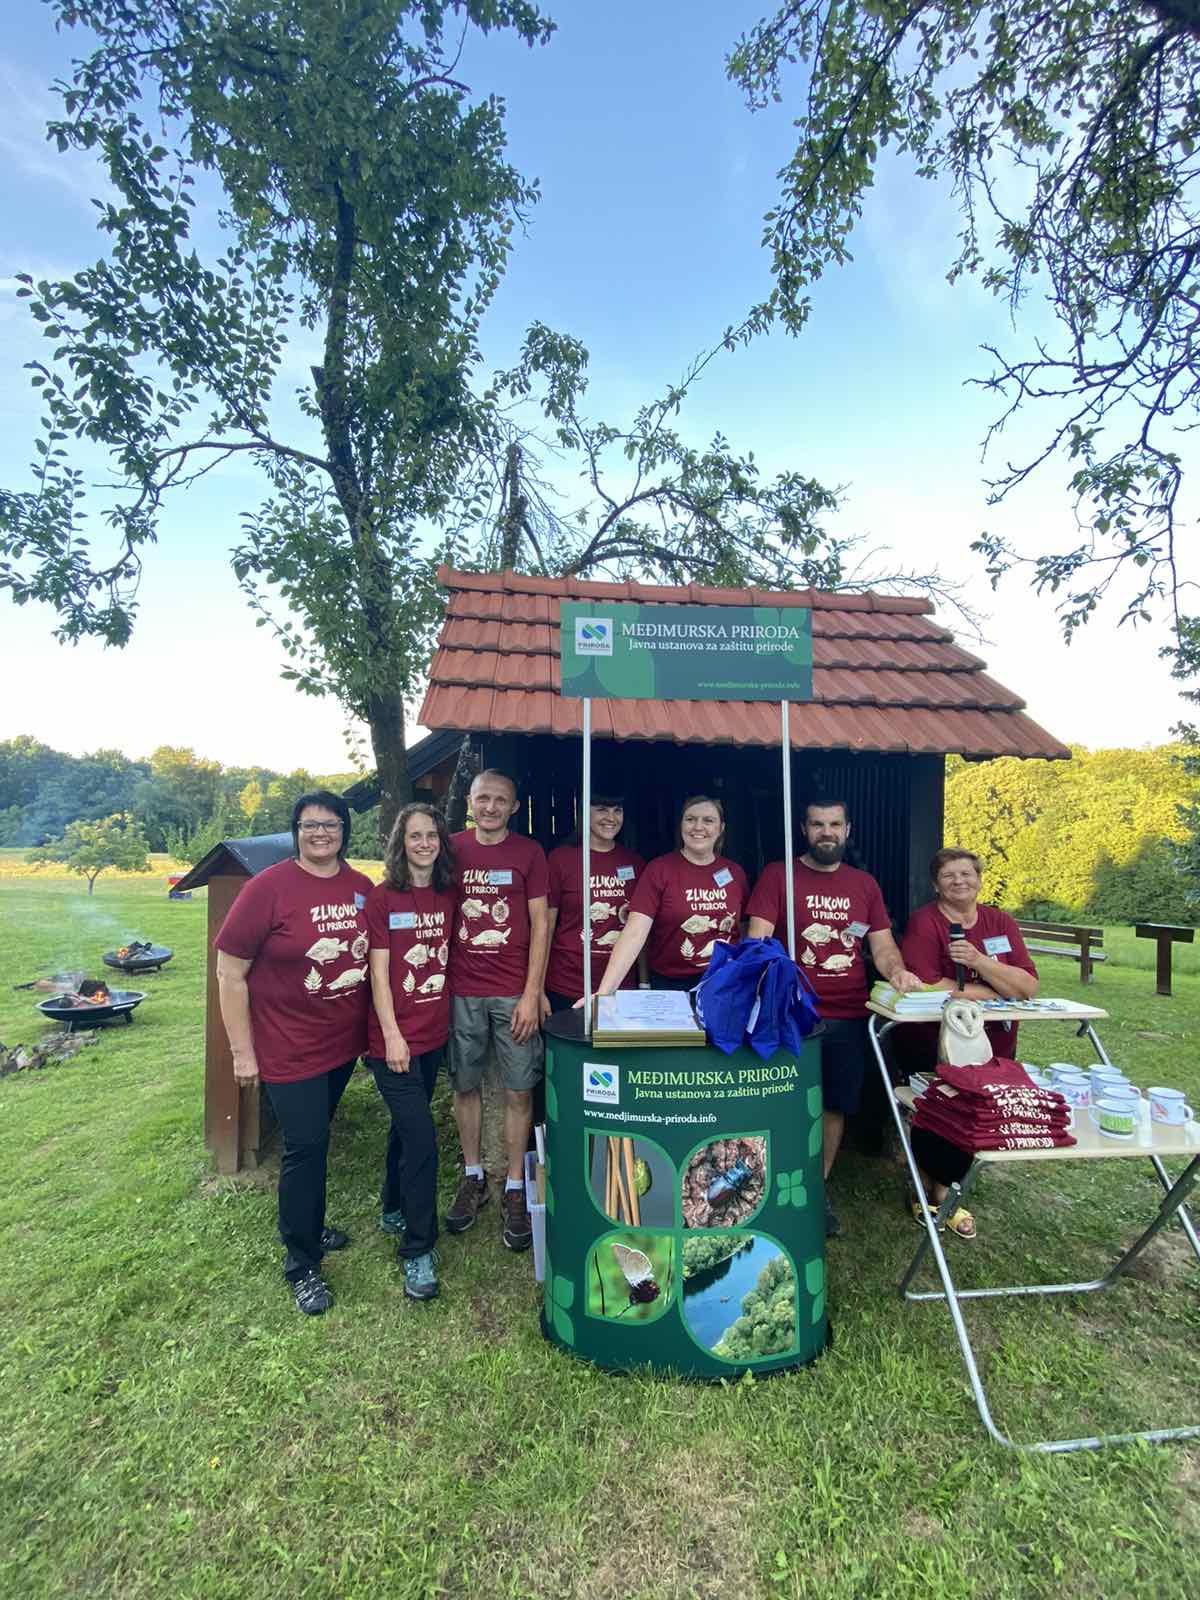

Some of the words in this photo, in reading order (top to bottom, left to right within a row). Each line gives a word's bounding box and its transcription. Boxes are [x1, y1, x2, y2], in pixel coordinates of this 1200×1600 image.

[622, 623, 728, 639] MEĐIMURSKA
[732, 624, 800, 639] PRIRODA
[628, 639, 657, 651] Javna
[659, 641, 704, 651] ustanova
[706, 642, 717, 651] za
[719, 639, 754, 651] zaštitu
[756, 642, 794, 653] prirode
[465, 886, 471, 895] U
[472, 886, 499, 895] PRIRODI
[593, 890, 599, 898] U
[686, 888, 728, 902] ZLIKOVO
[691, 903, 697, 911] U
[806, 895, 851, 911] ZLIKOVO
[811, 910, 819, 919] U
[820, 911, 849, 920] PRIRODI
[318, 923, 325, 933] U
[327, 920, 358, 931] PRIRODI
[416, 930, 422, 939] U
[628, 1070, 735, 1086] MEĐIMURSKA
[739, 1064, 799, 1083] PRIRODA
[586, 1089, 616, 1097] PRIRODA
[635, 1087, 662, 1100] Javna
[665, 1090, 711, 1099] ustanova
[713, 1090, 725, 1099] za
[727, 1086, 760, 1098] zaštitu
[762, 1082, 795, 1097] prirode
[584, 1108, 717, 1124] www.medjimurska-priroda.info
